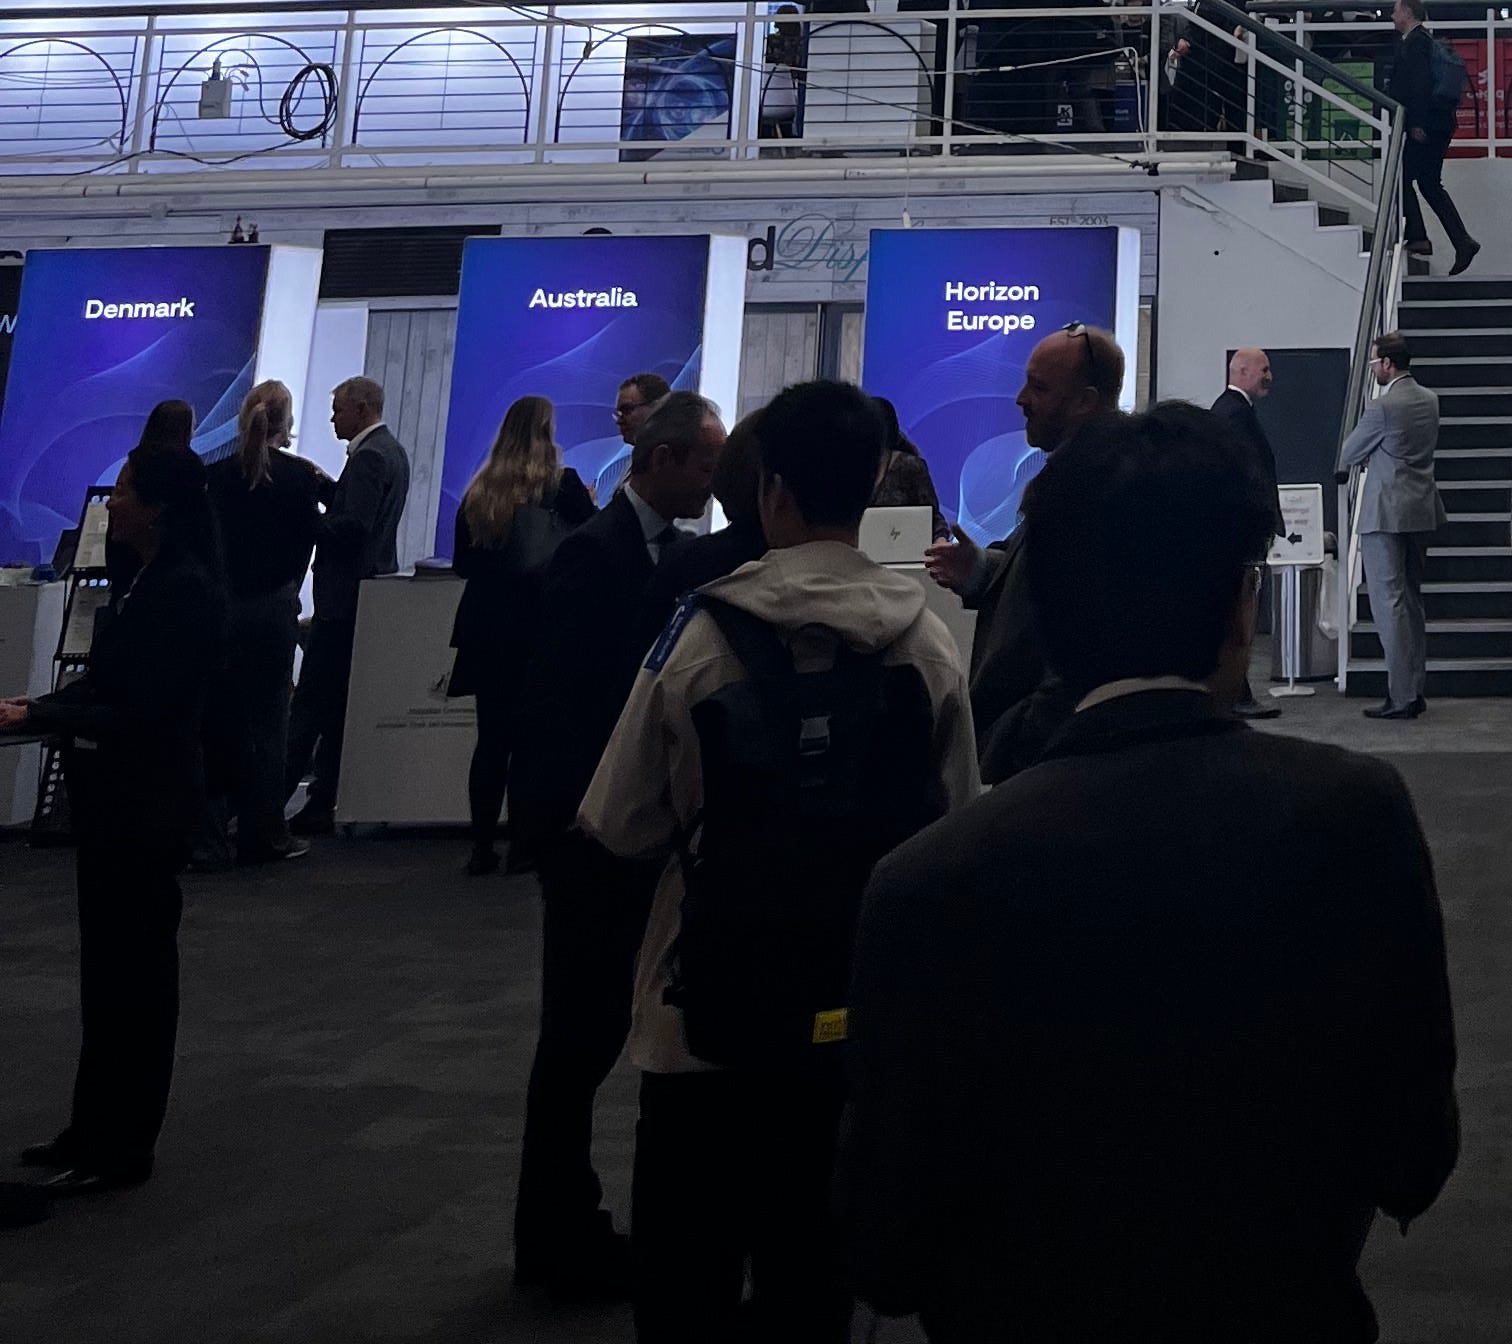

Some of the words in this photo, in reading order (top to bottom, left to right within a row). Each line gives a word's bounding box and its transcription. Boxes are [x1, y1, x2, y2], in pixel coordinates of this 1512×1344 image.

[529, 286, 639, 309] Australia
[945, 280, 1040, 303] Horizon
[85, 298, 196, 320] Denmark
[947, 310, 1036, 336] Europe
